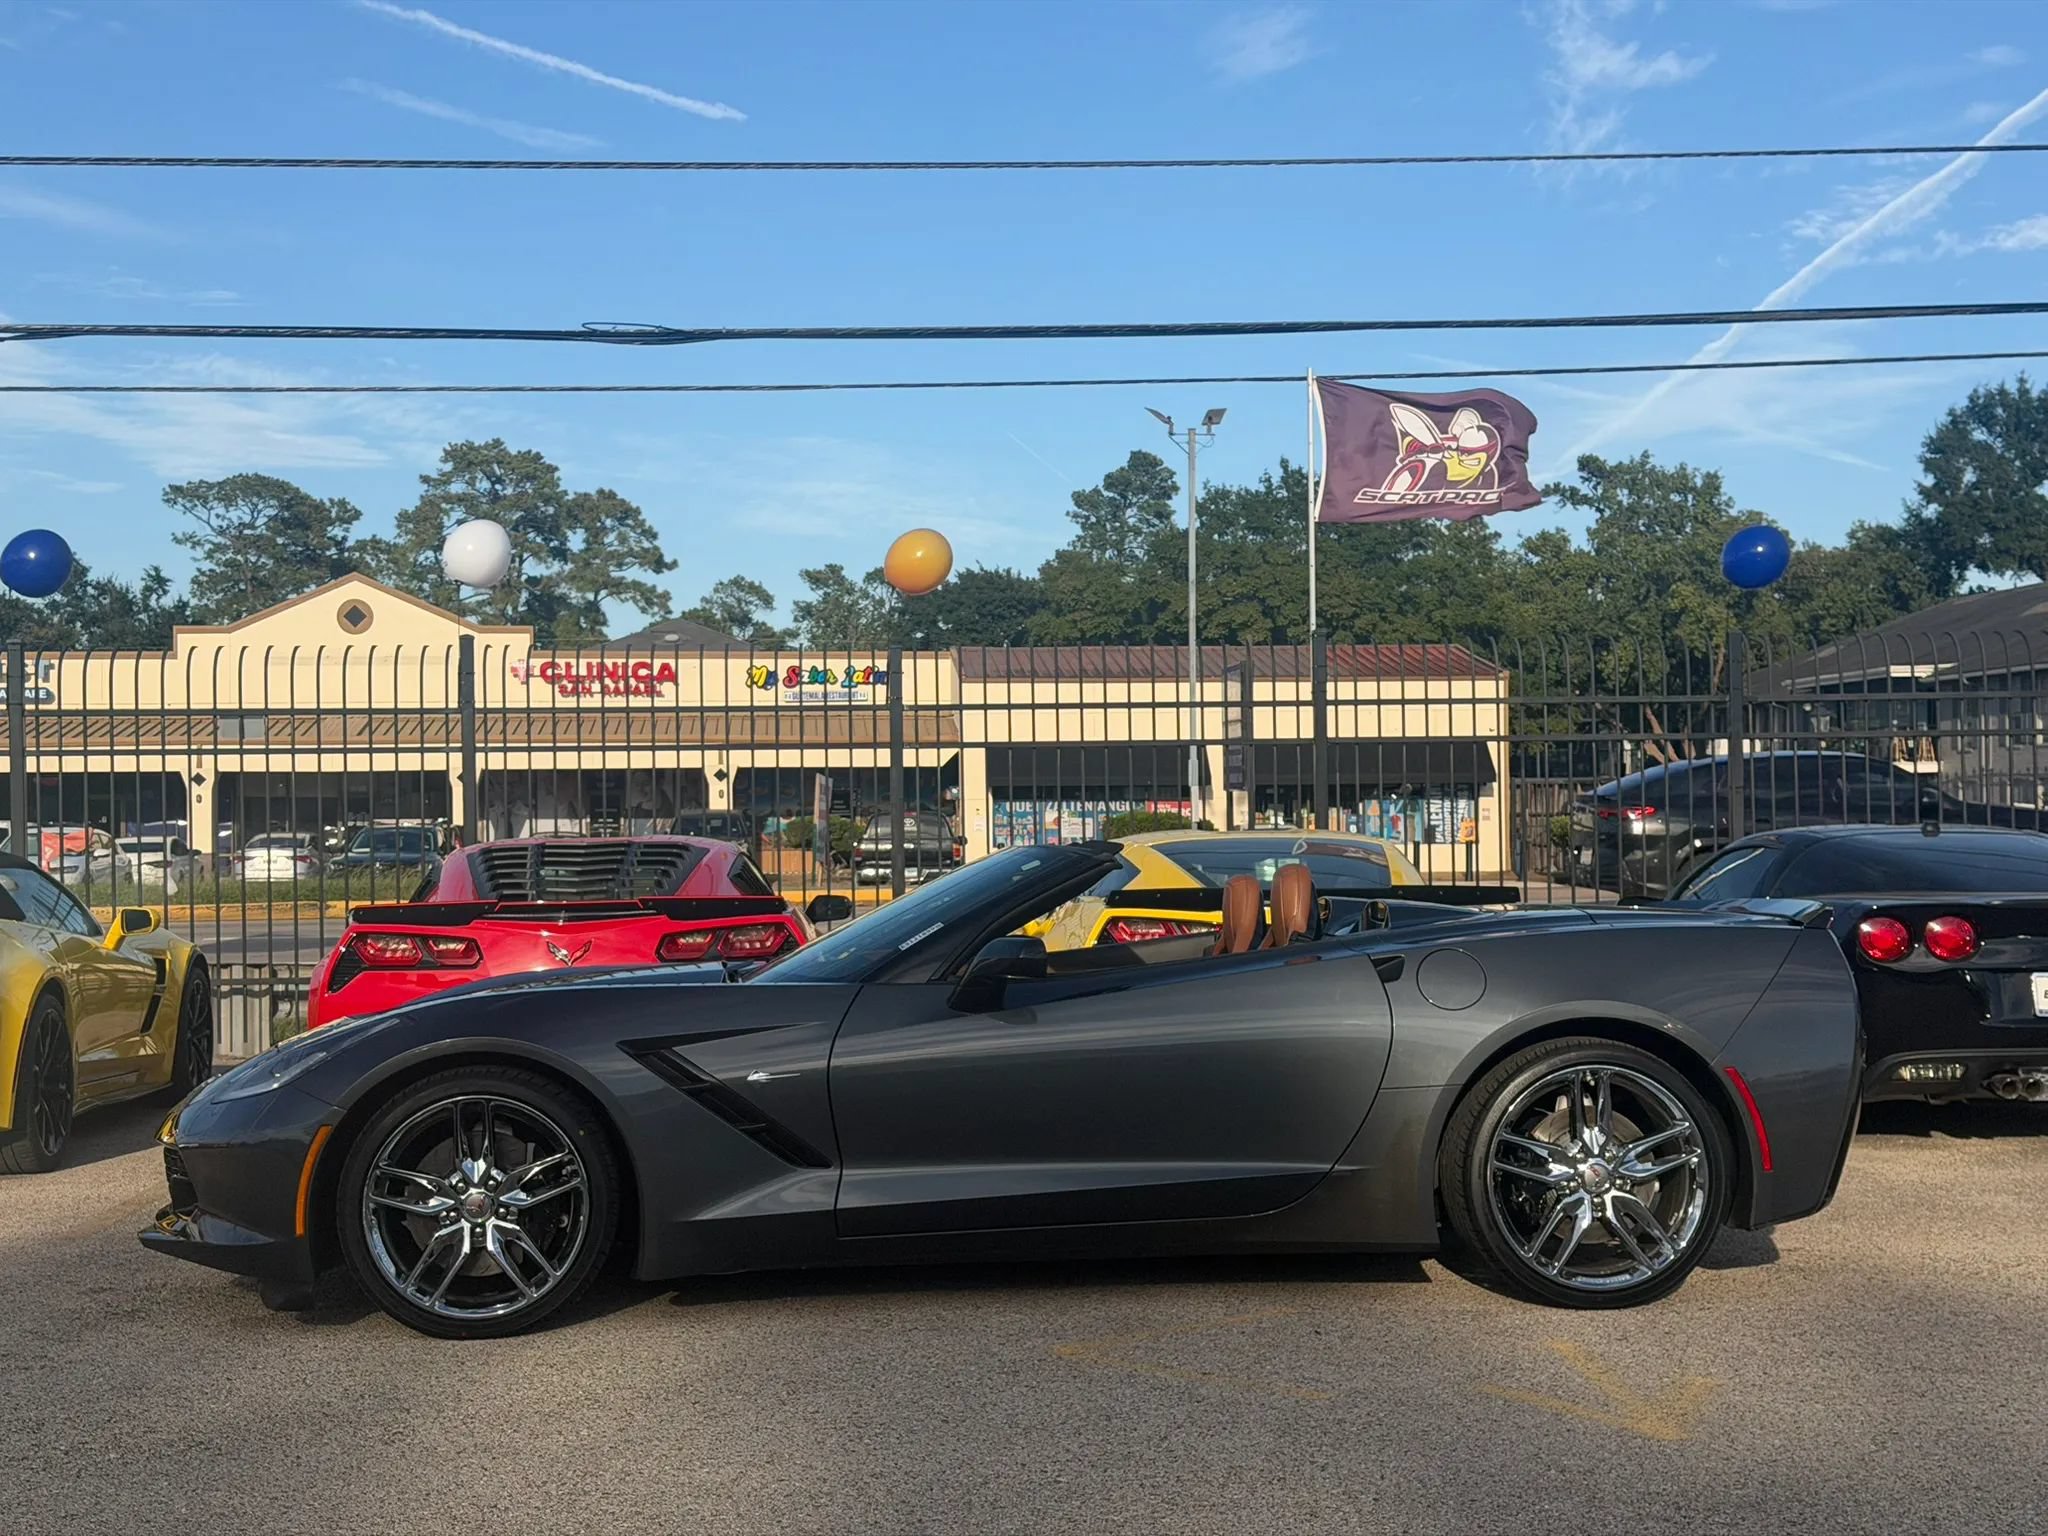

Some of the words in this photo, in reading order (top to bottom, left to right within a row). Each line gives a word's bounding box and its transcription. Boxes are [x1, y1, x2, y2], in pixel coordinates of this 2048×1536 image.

[1354, 489, 1502, 505] SCATPAC
[539, 661, 679, 686] CLINICA
[558, 684, 594, 698] SAN
[1005, 801, 1136, 812] QUEZALTENANGO
